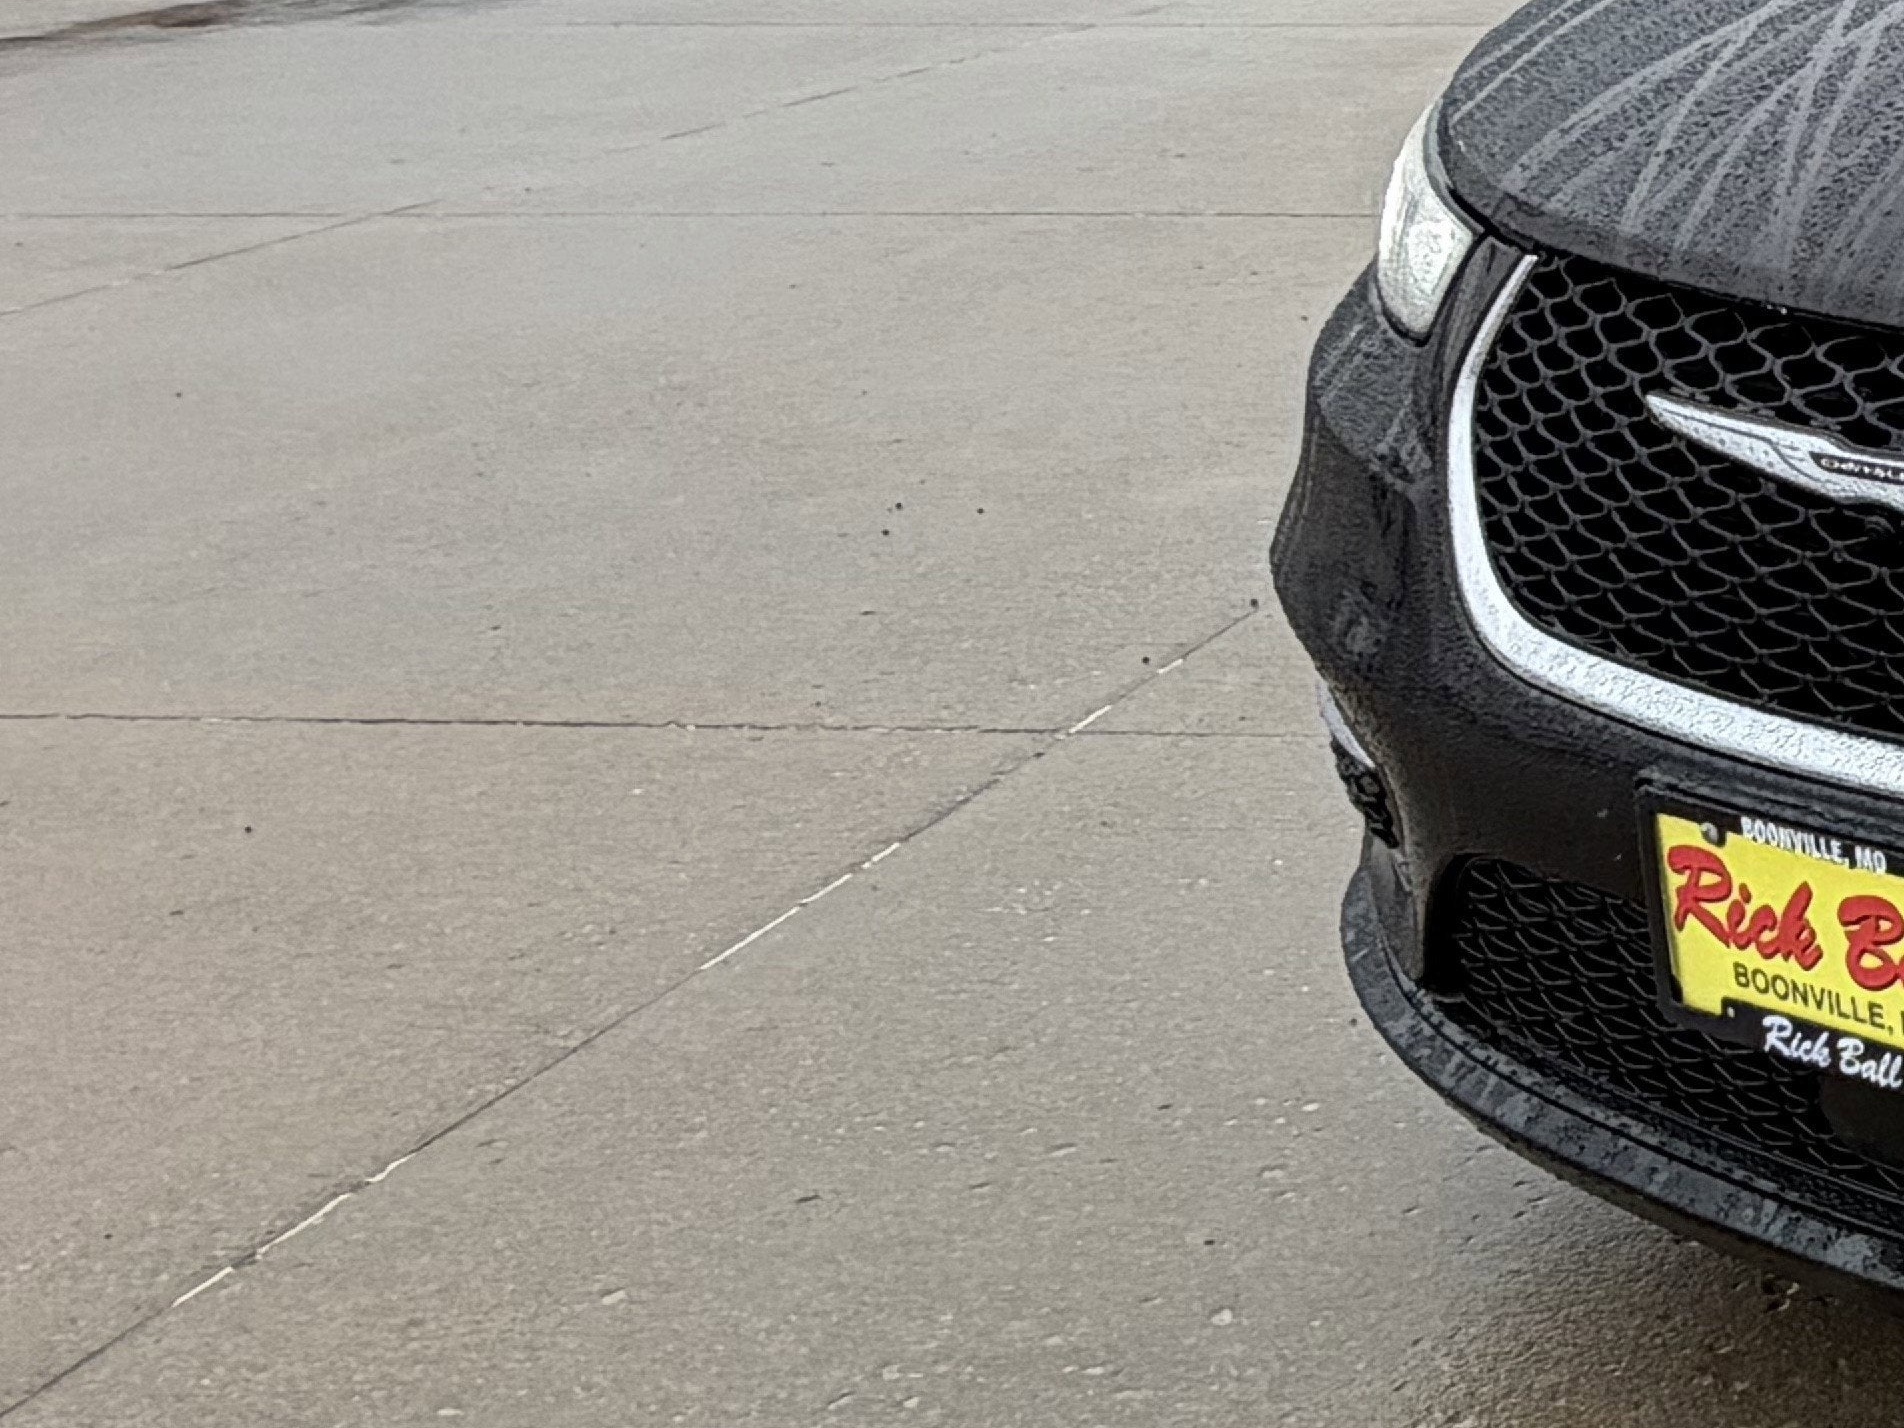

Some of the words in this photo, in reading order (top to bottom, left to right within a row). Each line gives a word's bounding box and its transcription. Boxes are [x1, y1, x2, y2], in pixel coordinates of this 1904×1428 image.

[1740, 816, 1850, 866] BOONVILLE,
[1855, 846, 1888, 875] MO
[1667, 845, 1824, 971] Rick
[1734, 962, 1894, 1035] BOONVILLE,
[1762, 1015, 1832, 1068] Rick
[1836, 1038, 1904, 1090] Ball
